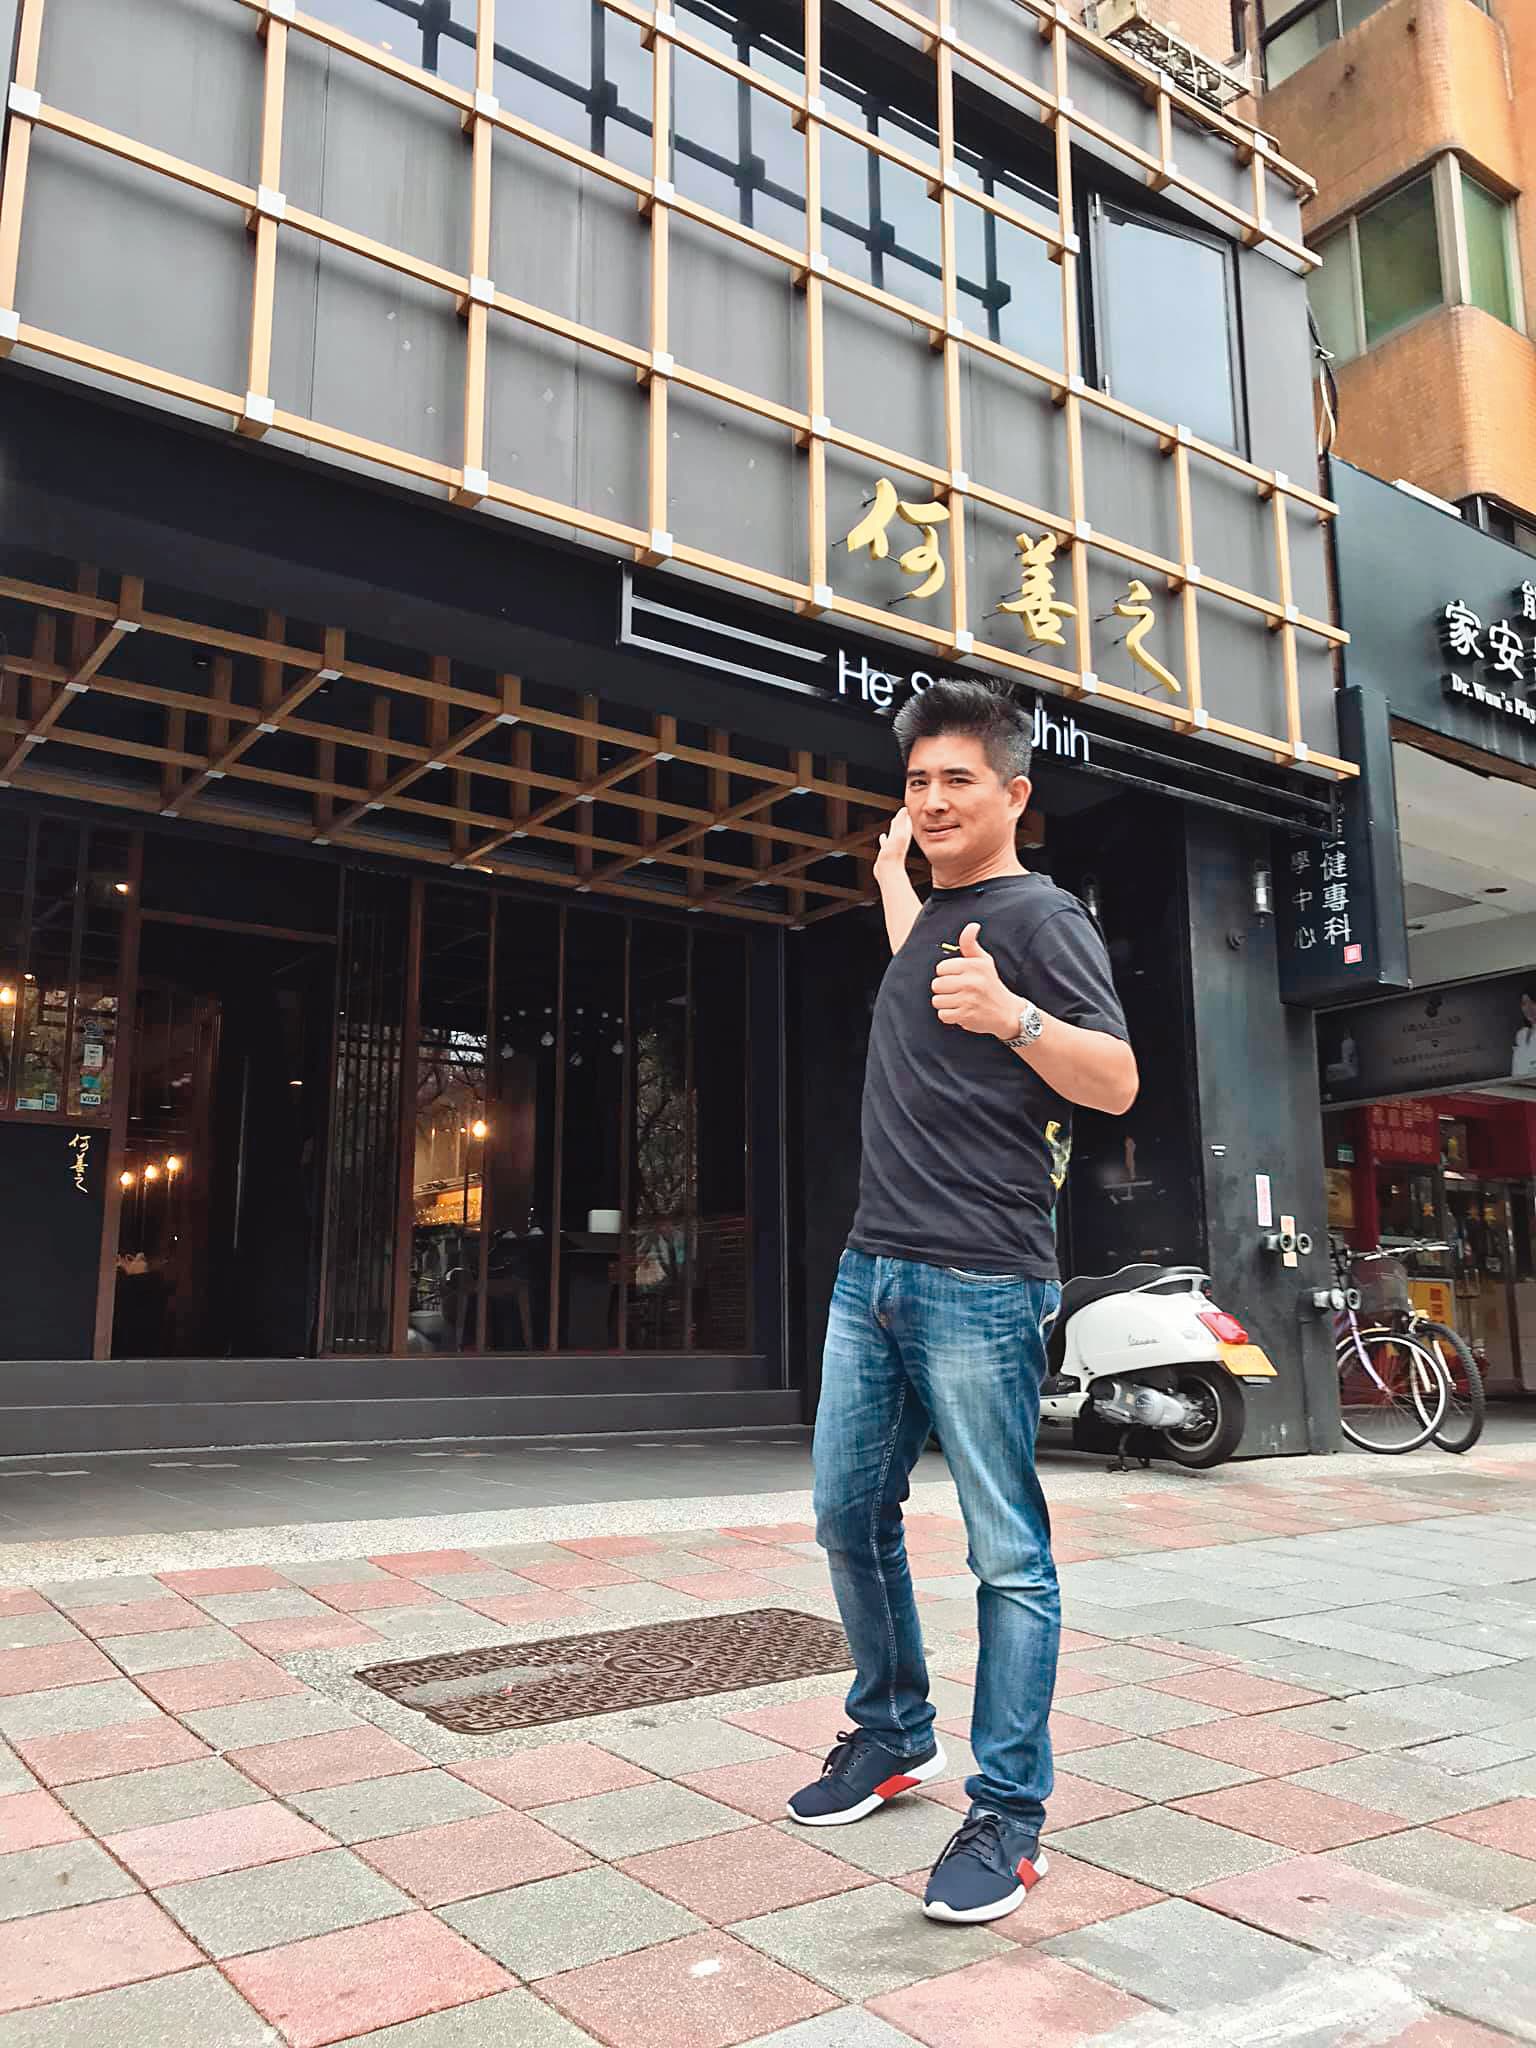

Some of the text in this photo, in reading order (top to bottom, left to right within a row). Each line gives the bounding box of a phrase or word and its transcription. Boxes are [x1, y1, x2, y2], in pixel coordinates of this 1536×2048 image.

[847, 478, 1182, 694] 何善之
[838, 649, 894, 707] He
[1445, 599, 1536, 679] 家安
[1290, 832, 1317, 950] 學中心
[68, 1133, 92, 1194] 何善之
